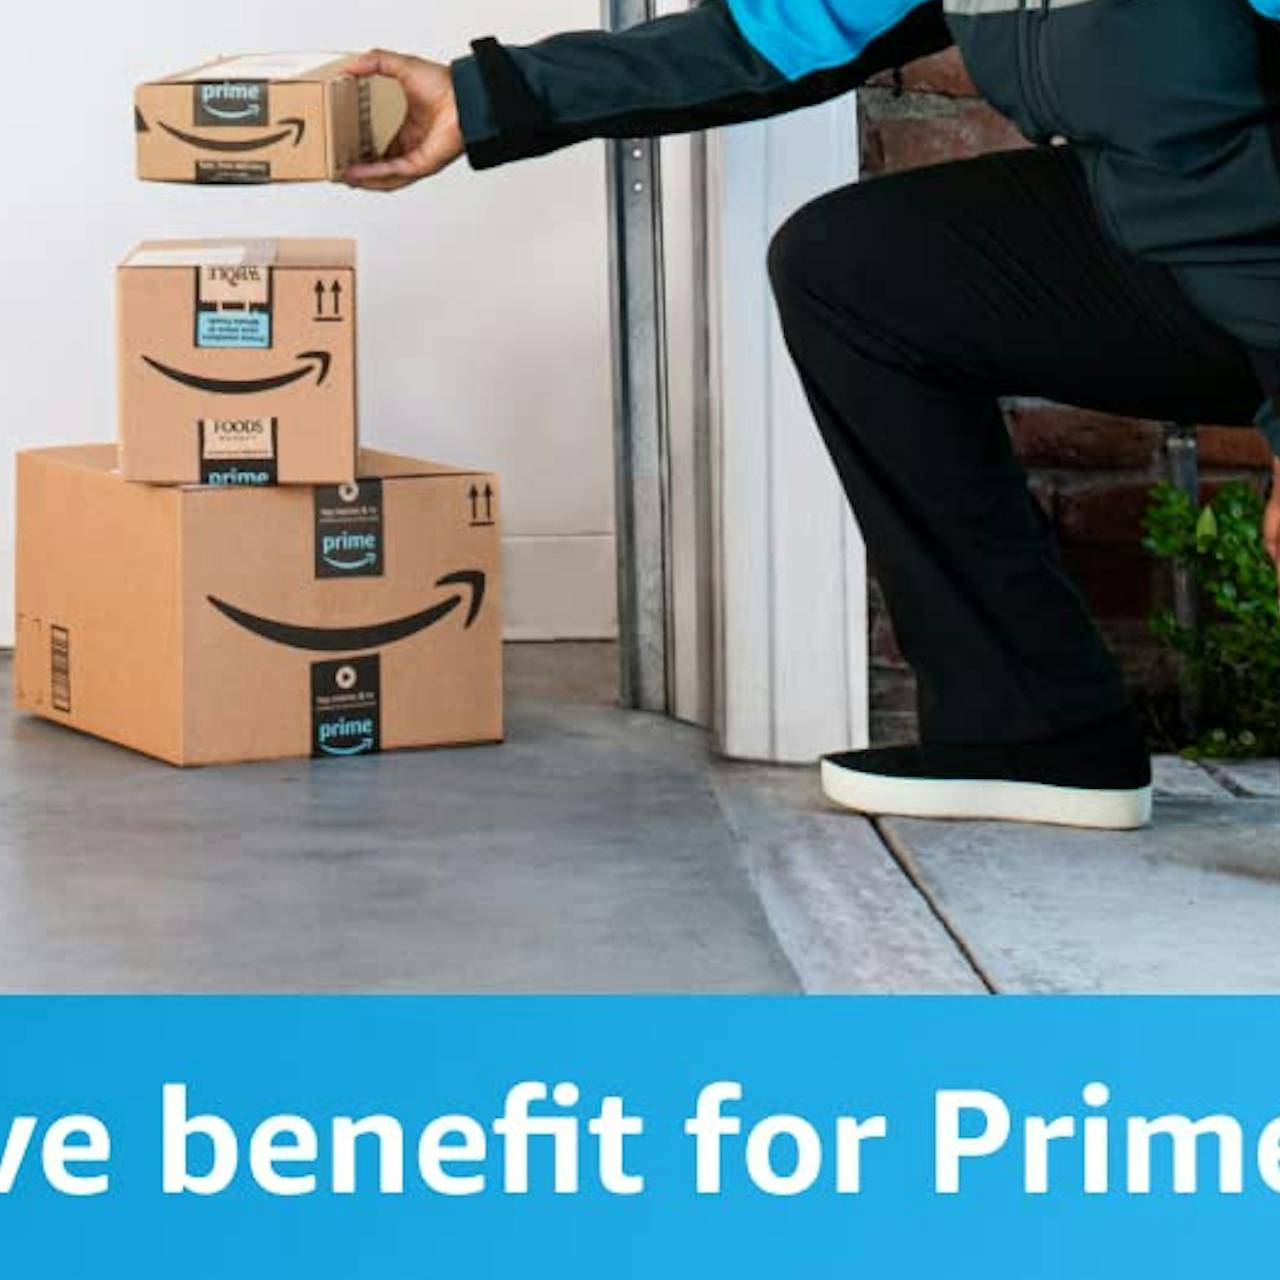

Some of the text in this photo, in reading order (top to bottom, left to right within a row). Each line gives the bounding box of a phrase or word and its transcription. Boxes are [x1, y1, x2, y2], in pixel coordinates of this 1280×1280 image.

[202, 81, 260, 103] prime
[208, 468, 269, 486] prime
[323, 530, 377, 554] prime
[319, 717, 372, 742] prime
